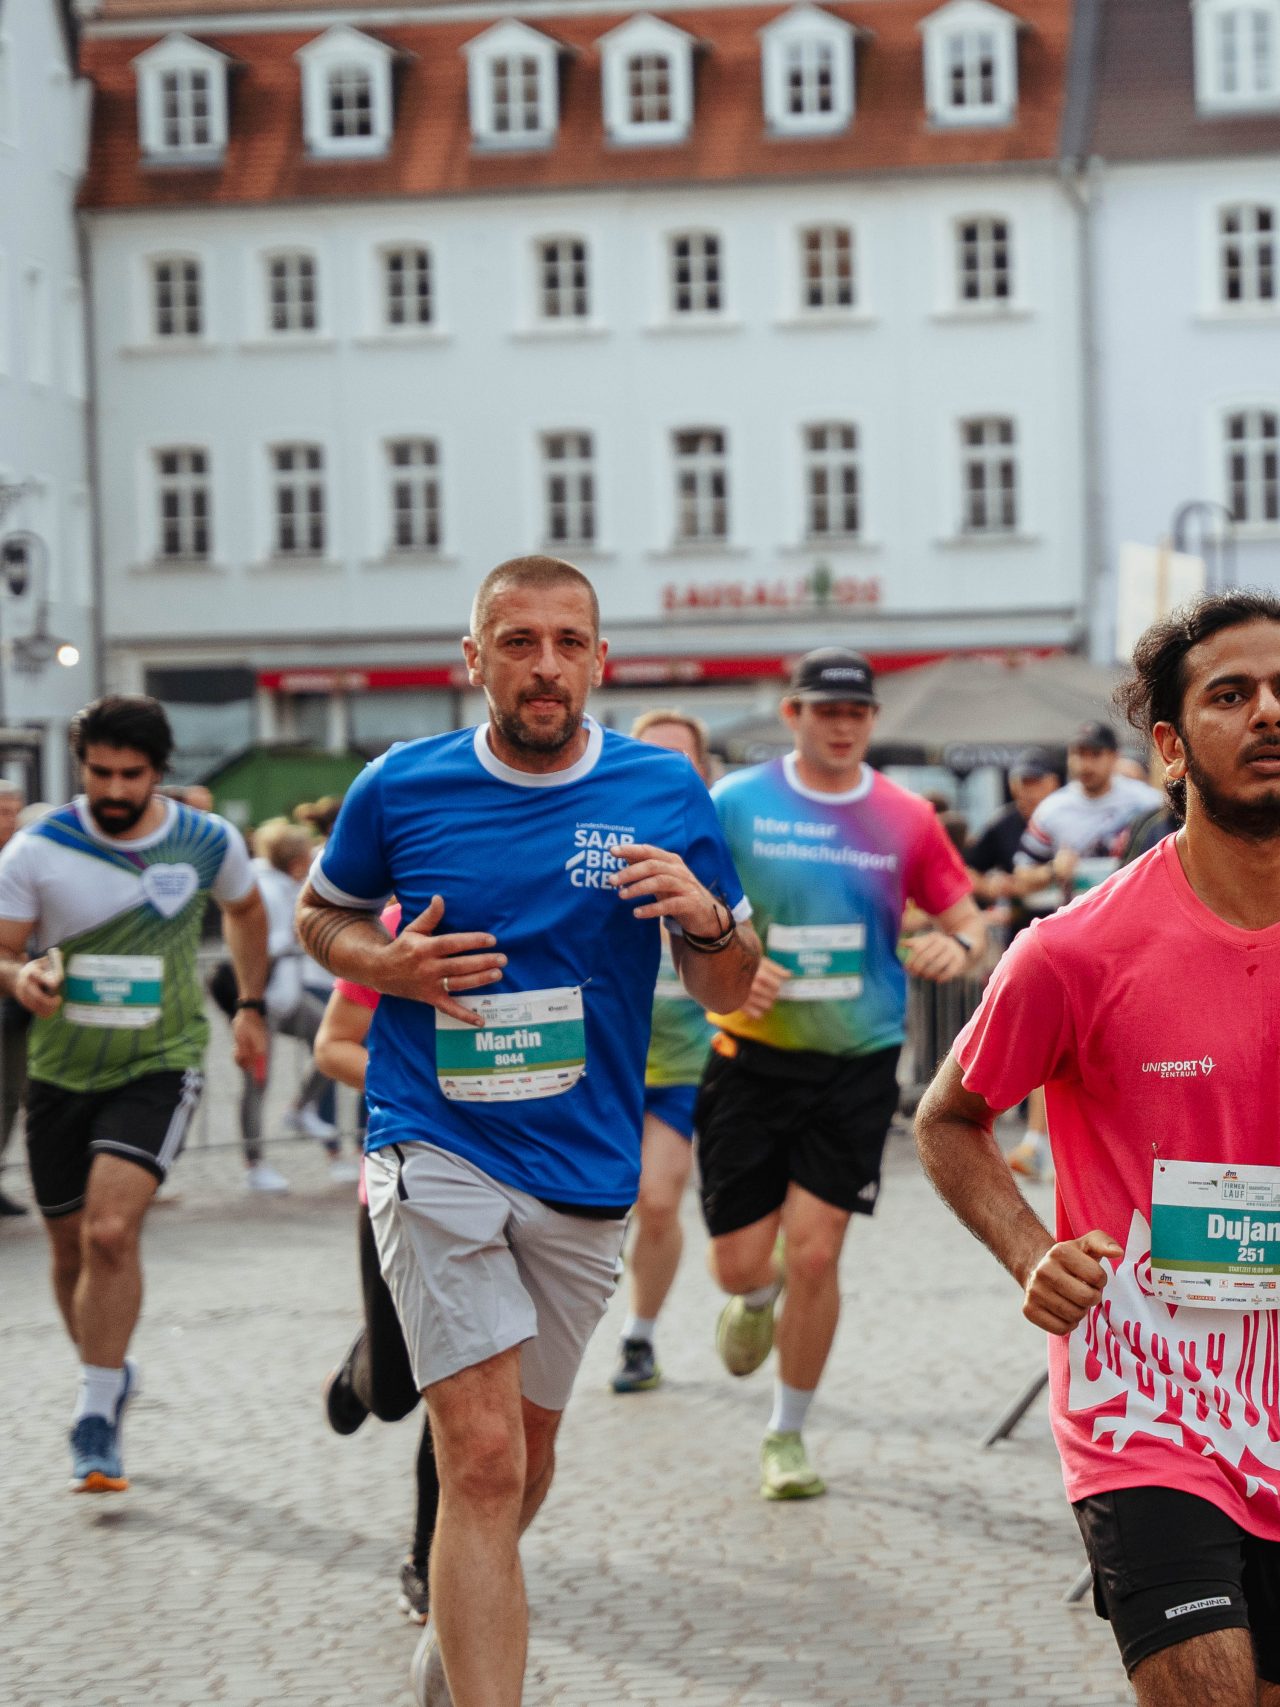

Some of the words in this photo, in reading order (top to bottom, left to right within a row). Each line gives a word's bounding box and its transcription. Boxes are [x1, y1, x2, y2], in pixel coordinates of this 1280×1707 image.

[794, 821, 838, 838] saar
[753, 839, 899, 872] hochschulsport
[570, 868, 623, 889] CKE
[475, 1029, 542, 1051] Martin
[495, 1052, 525, 1066] 8044
[1142, 1060, 1198, 1072] UNISPORT
[1160, 1070, 1197, 1078] ZENTRUM
[1223, 1190, 1245, 1199] LAUF
[1237, 1247, 1265, 1262] 251
[1172, 1598, 1227, 1615] TRAINING
